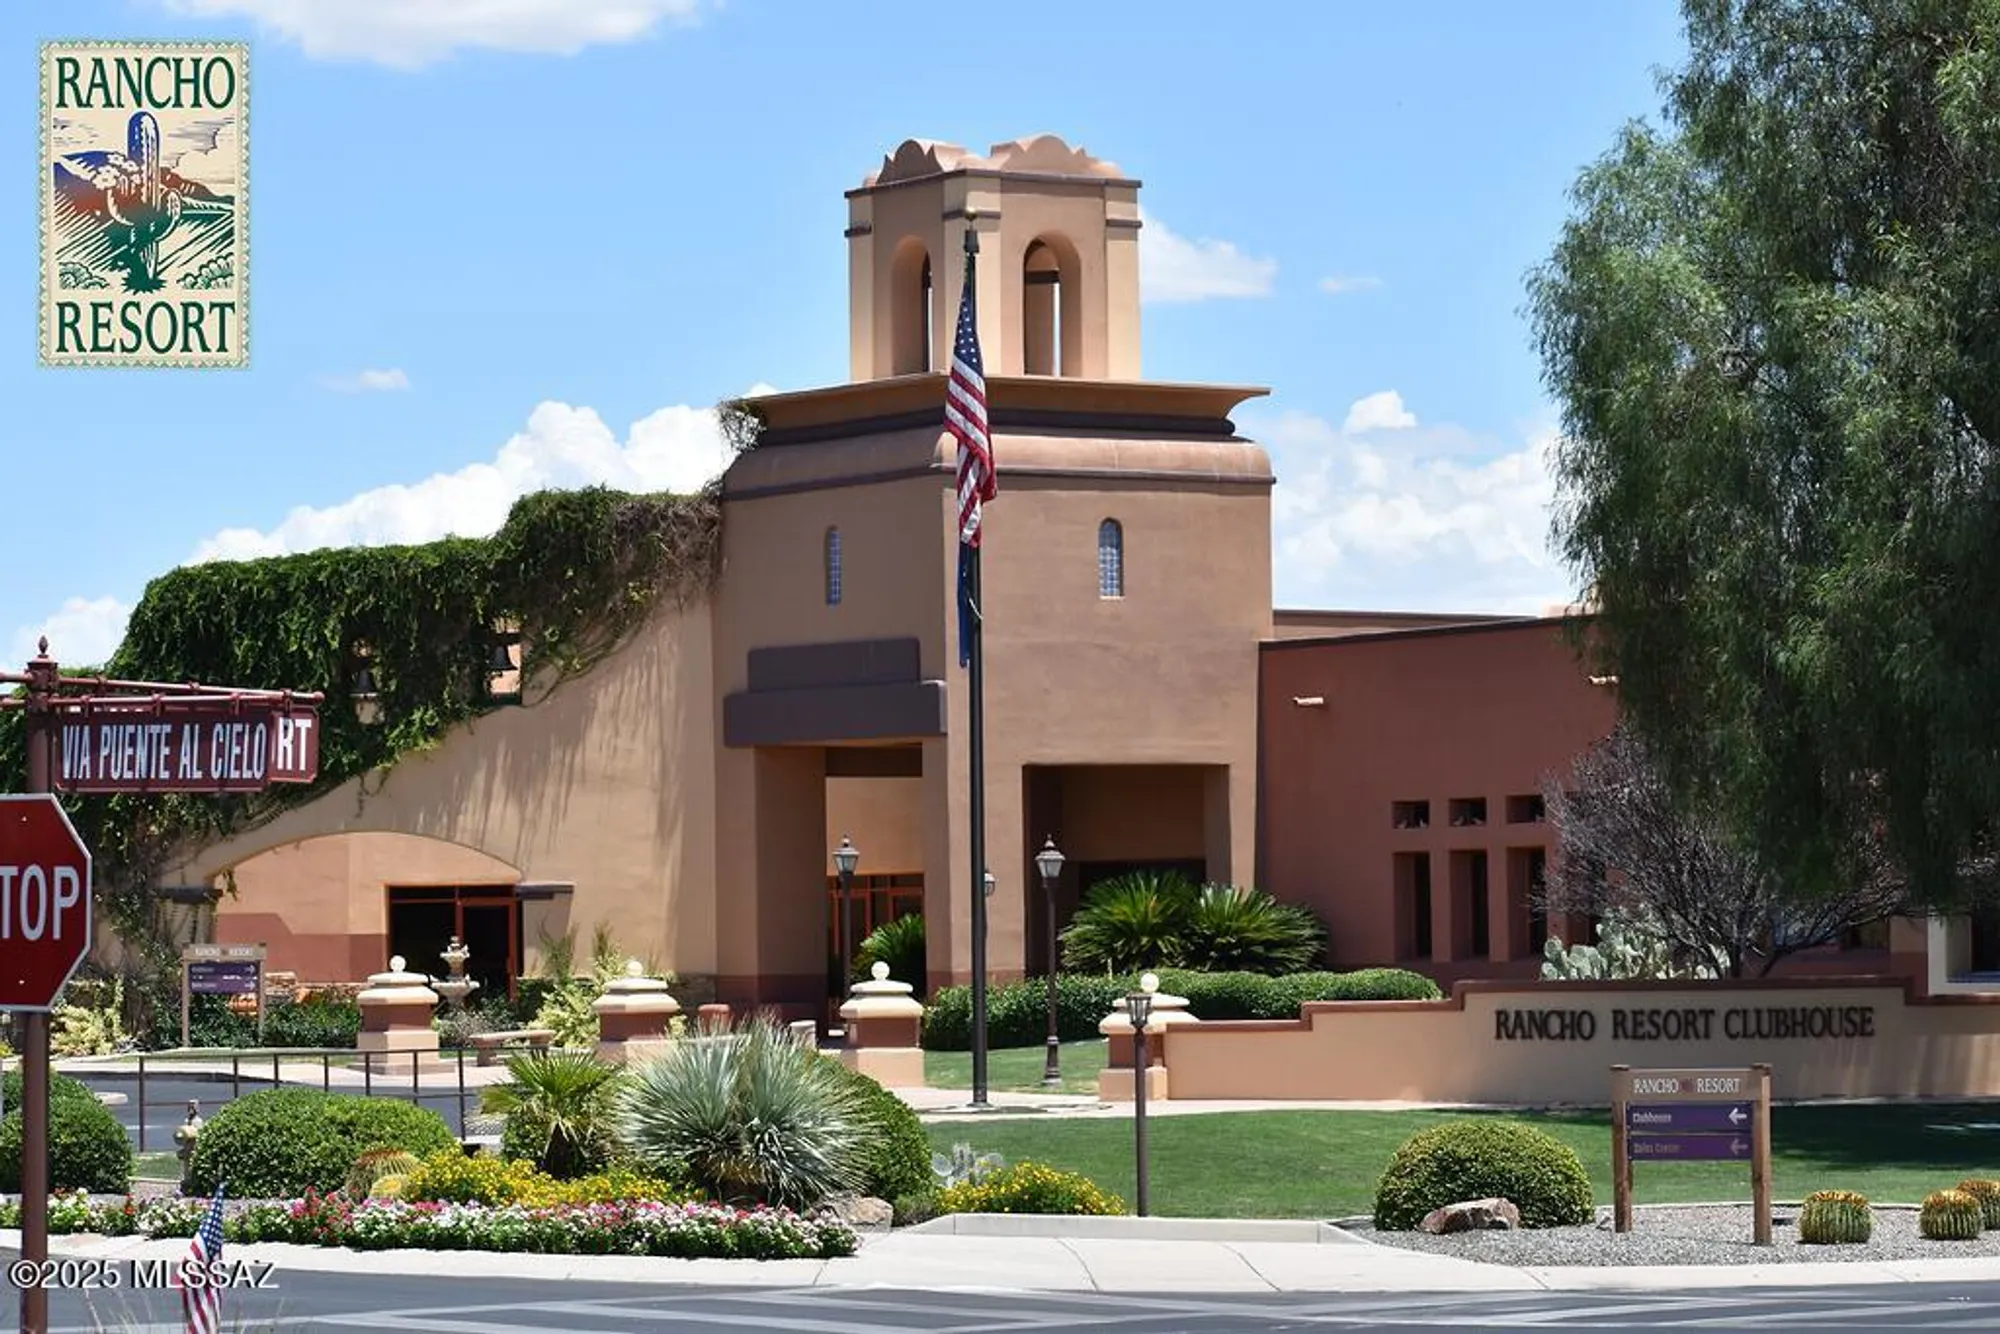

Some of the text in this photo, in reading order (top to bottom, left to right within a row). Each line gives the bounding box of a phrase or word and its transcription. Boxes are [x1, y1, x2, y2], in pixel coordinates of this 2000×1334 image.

[62, 722, 267, 780] VIA PUENTE AL CIELO
[271, 717, 312, 772] RT
[0, 864, 80, 941] TOP
[1495, 1006, 1876, 1041] RANCHO RESORT CLUBHOUSE
[1633, 1078, 1741, 1094] RANCHO RESORT
